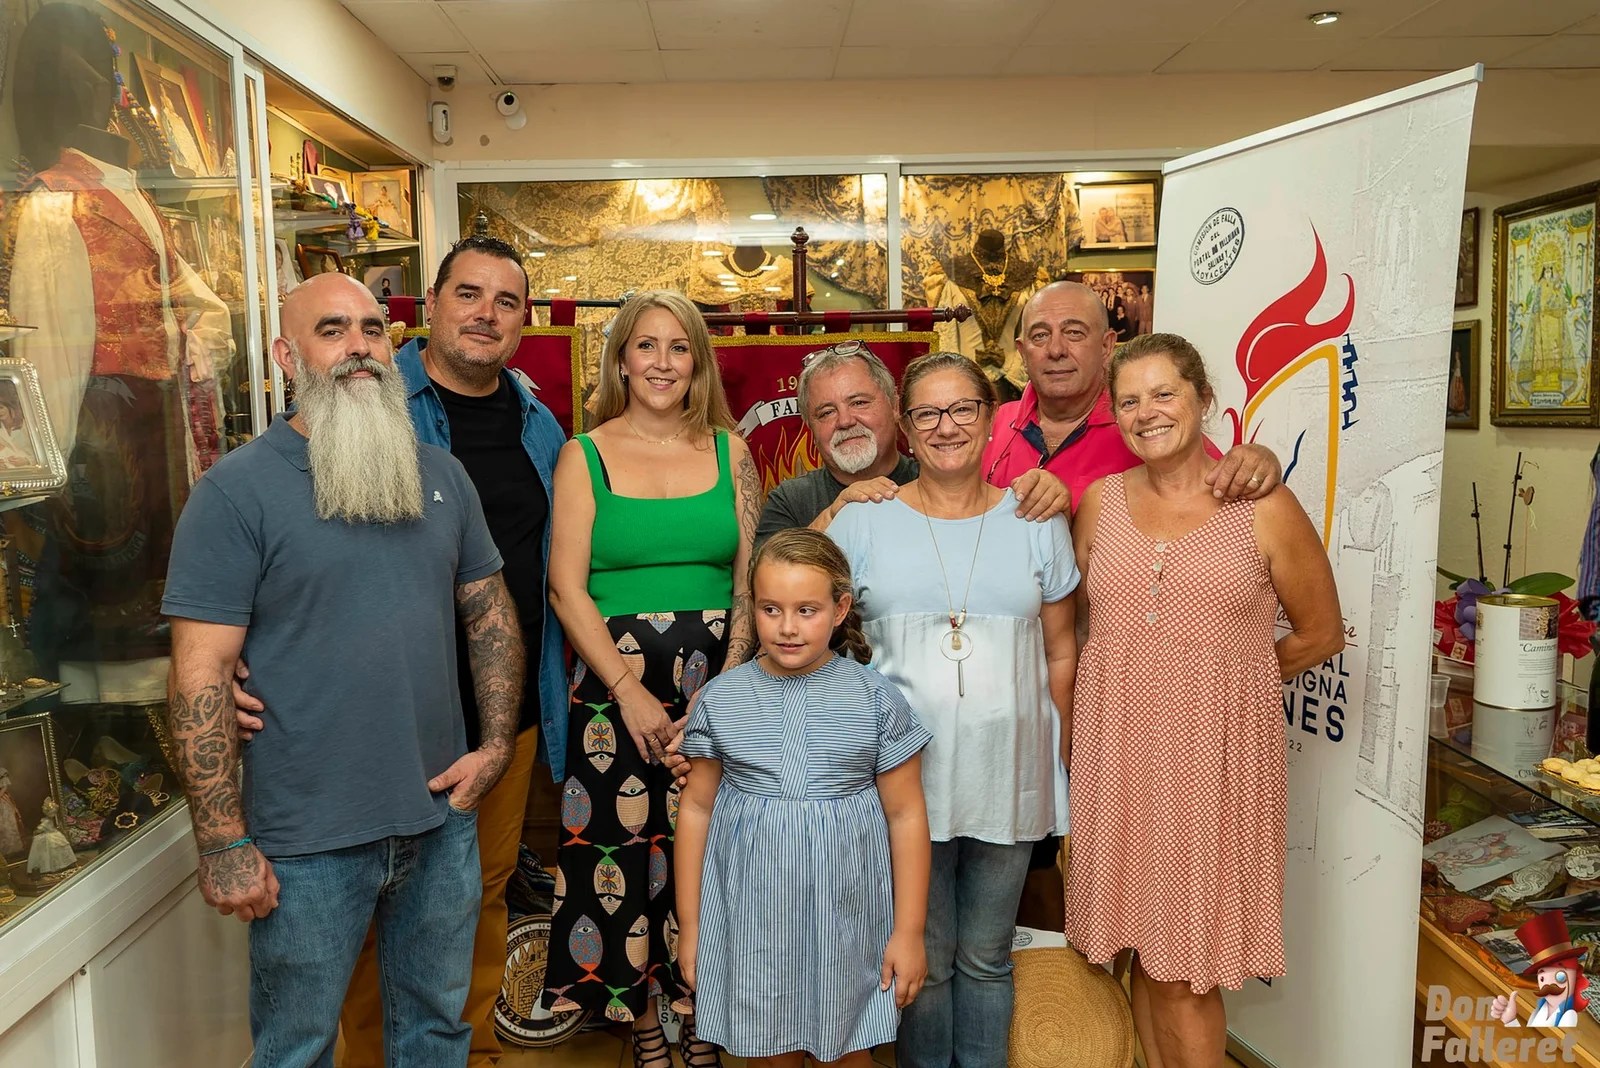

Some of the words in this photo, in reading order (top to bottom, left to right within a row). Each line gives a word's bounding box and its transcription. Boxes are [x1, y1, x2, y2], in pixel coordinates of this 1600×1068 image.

[776, 375, 798, 393] 19
[1321, 652, 1350, 678] AL
[1282, 690, 1345, 743] NES
[1288, 739, 1303, 753] 22
[496, 999, 522, 1025] 1922
